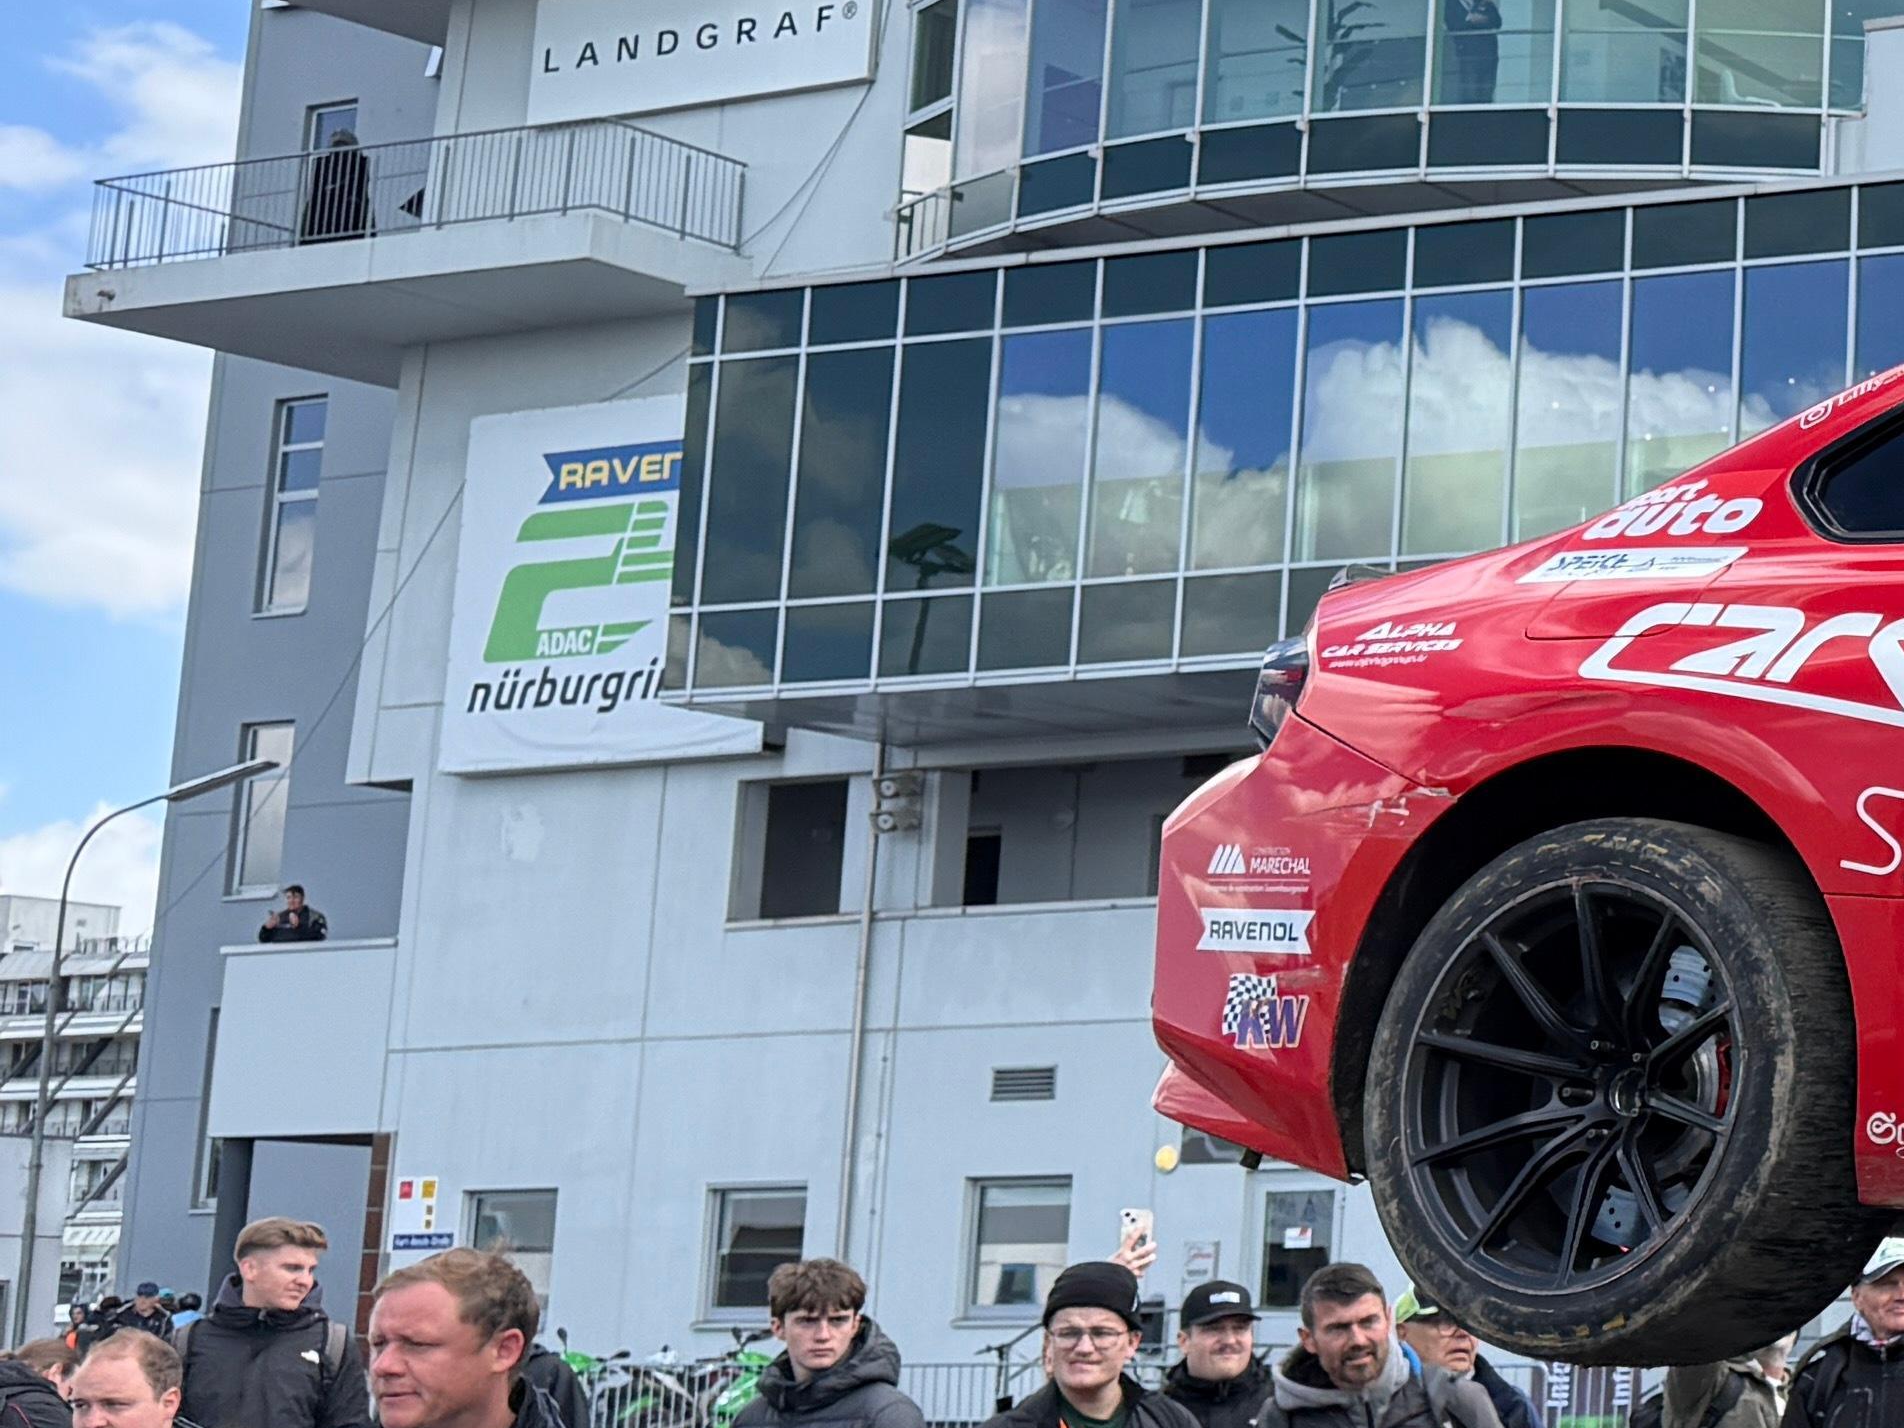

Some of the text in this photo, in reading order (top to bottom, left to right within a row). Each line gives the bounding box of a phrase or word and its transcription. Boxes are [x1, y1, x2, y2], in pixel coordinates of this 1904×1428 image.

[1582, 492, 1764, 540] auto
[536, 627, 594, 657] ADAC
[1209, 919, 1299, 942] RAVENOL
